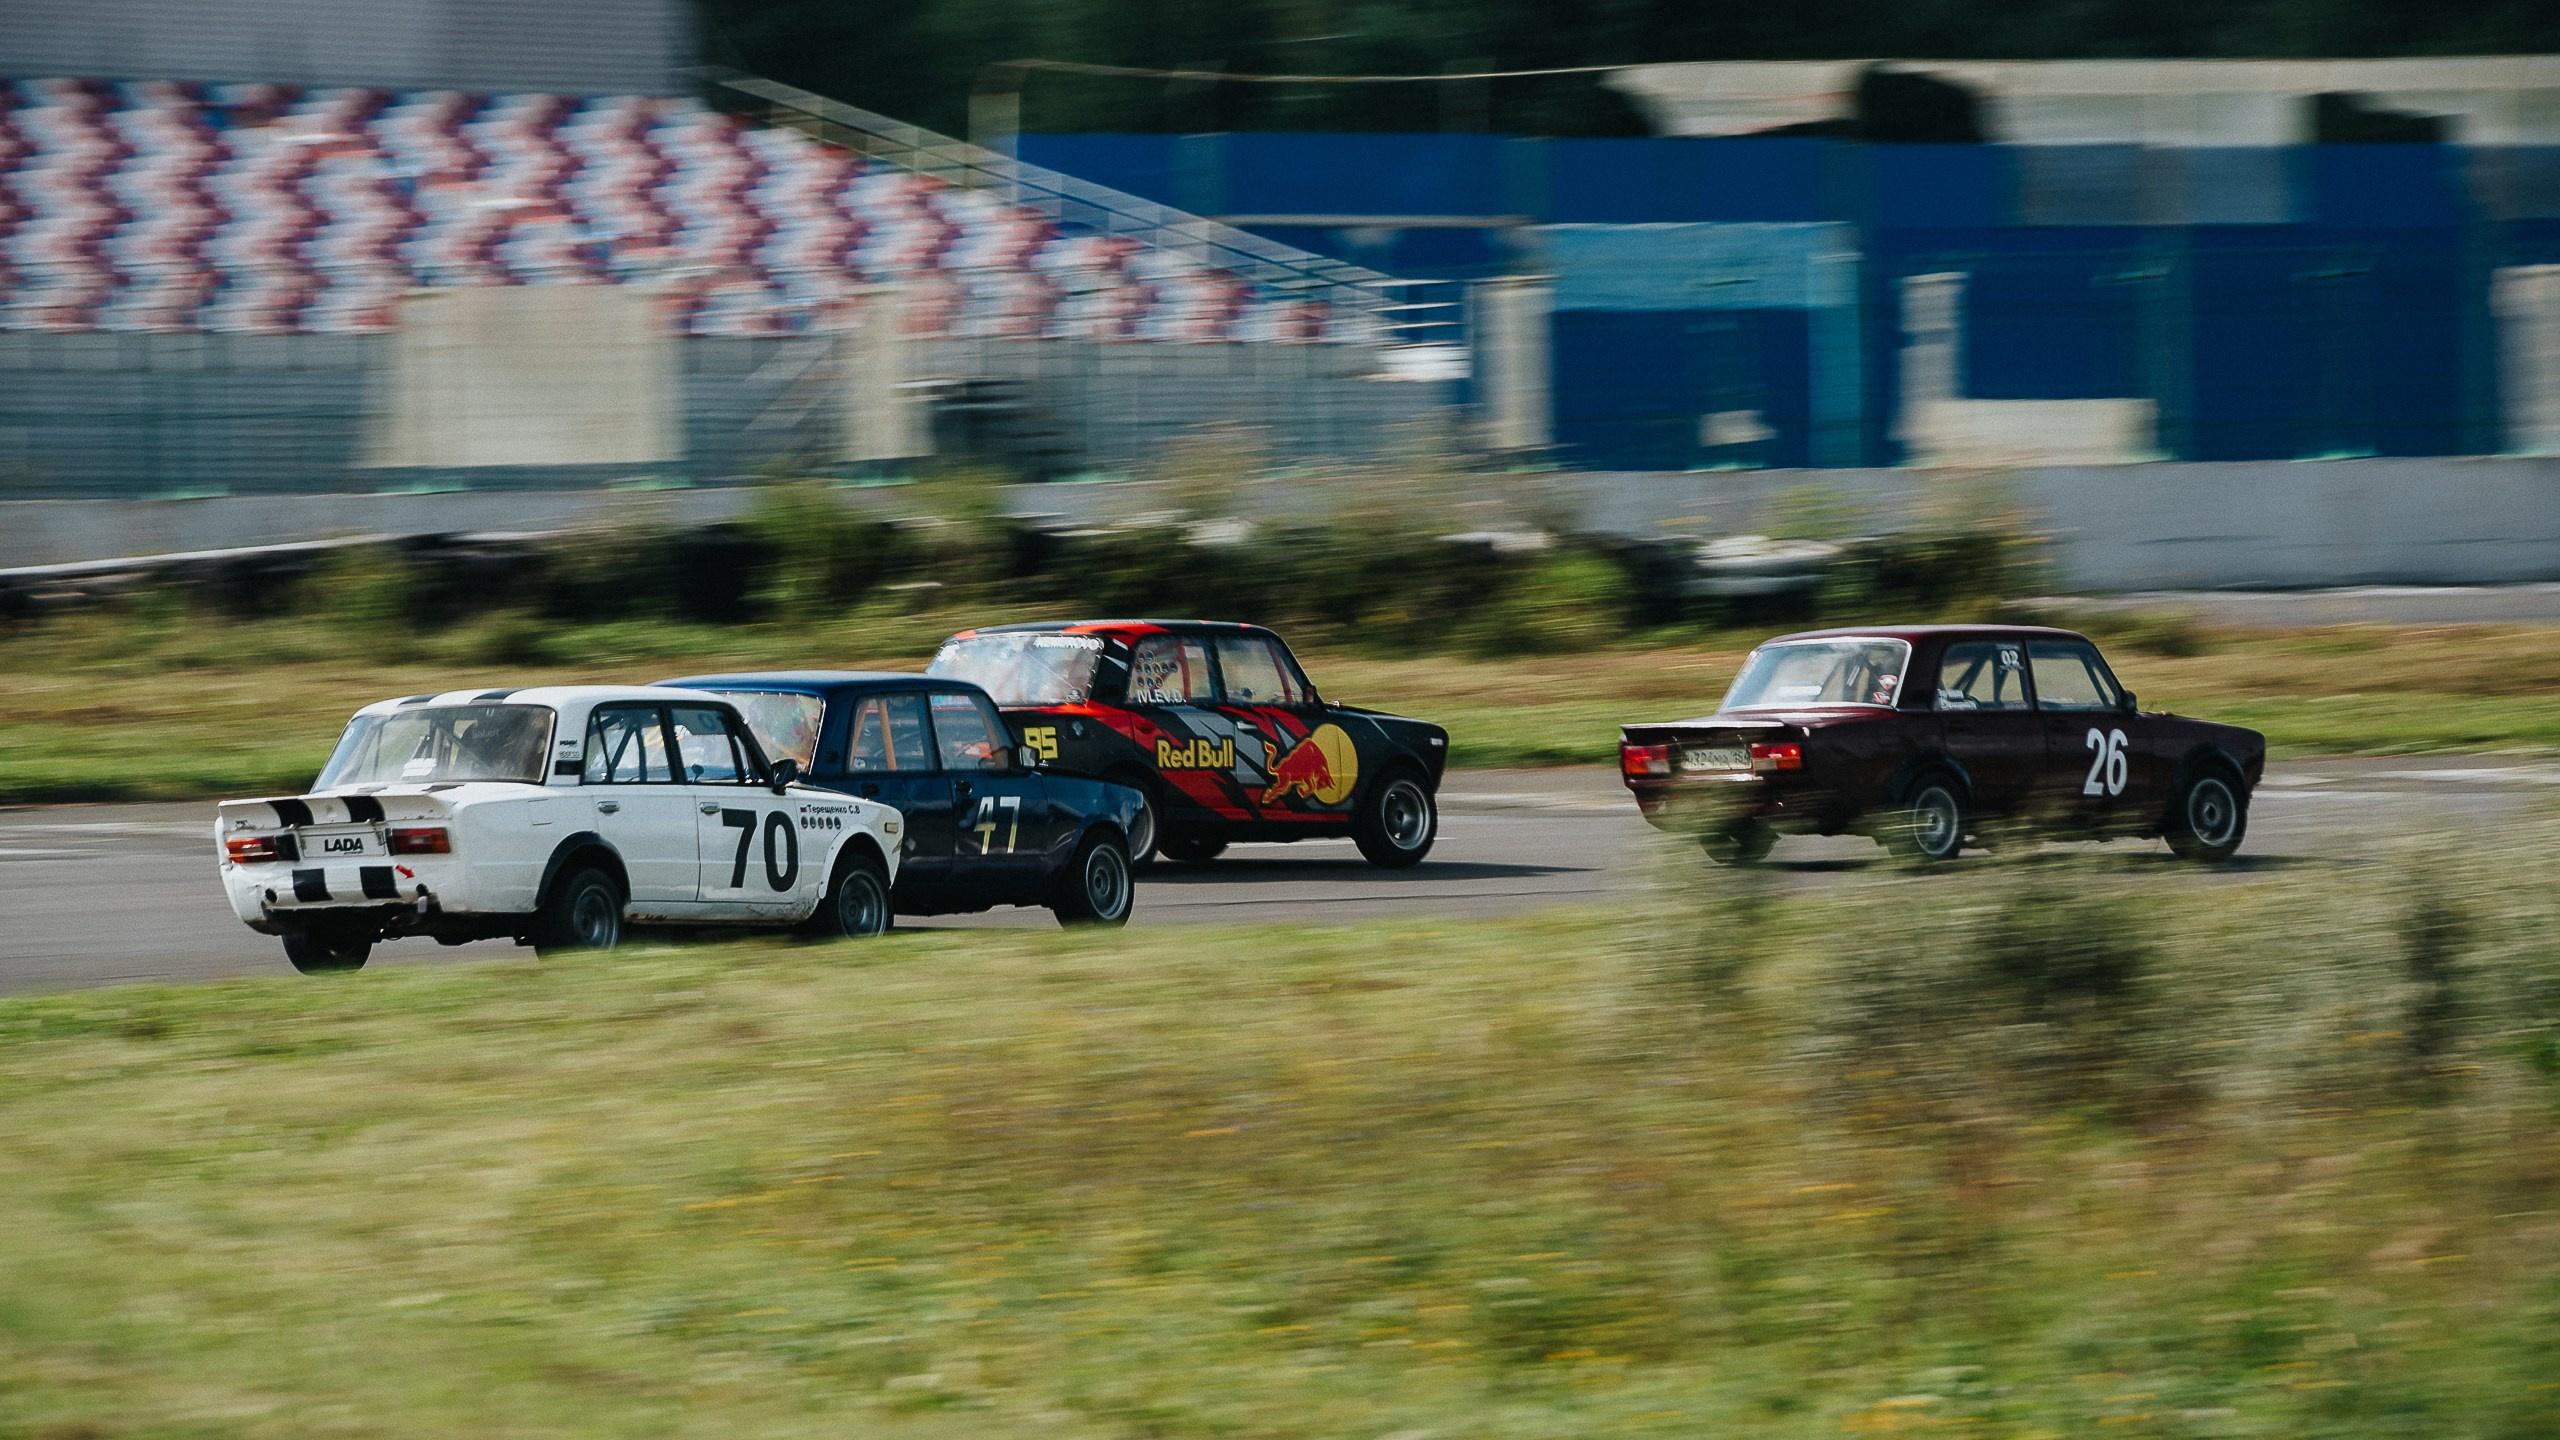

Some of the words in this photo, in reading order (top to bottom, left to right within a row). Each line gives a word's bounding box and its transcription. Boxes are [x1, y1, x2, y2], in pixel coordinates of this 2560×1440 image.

[1023, 726, 1058, 760] 95
[1157, 739, 1195, 768] Red
[1197, 739, 1234, 768] Bull
[2083, 727, 2128, 796] 26
[807, 804, 847, 815] Терещенко
[974, 796, 1021, 855] 47
[324, 837, 364, 852] LADA
[721, 808, 798, 893] 70
